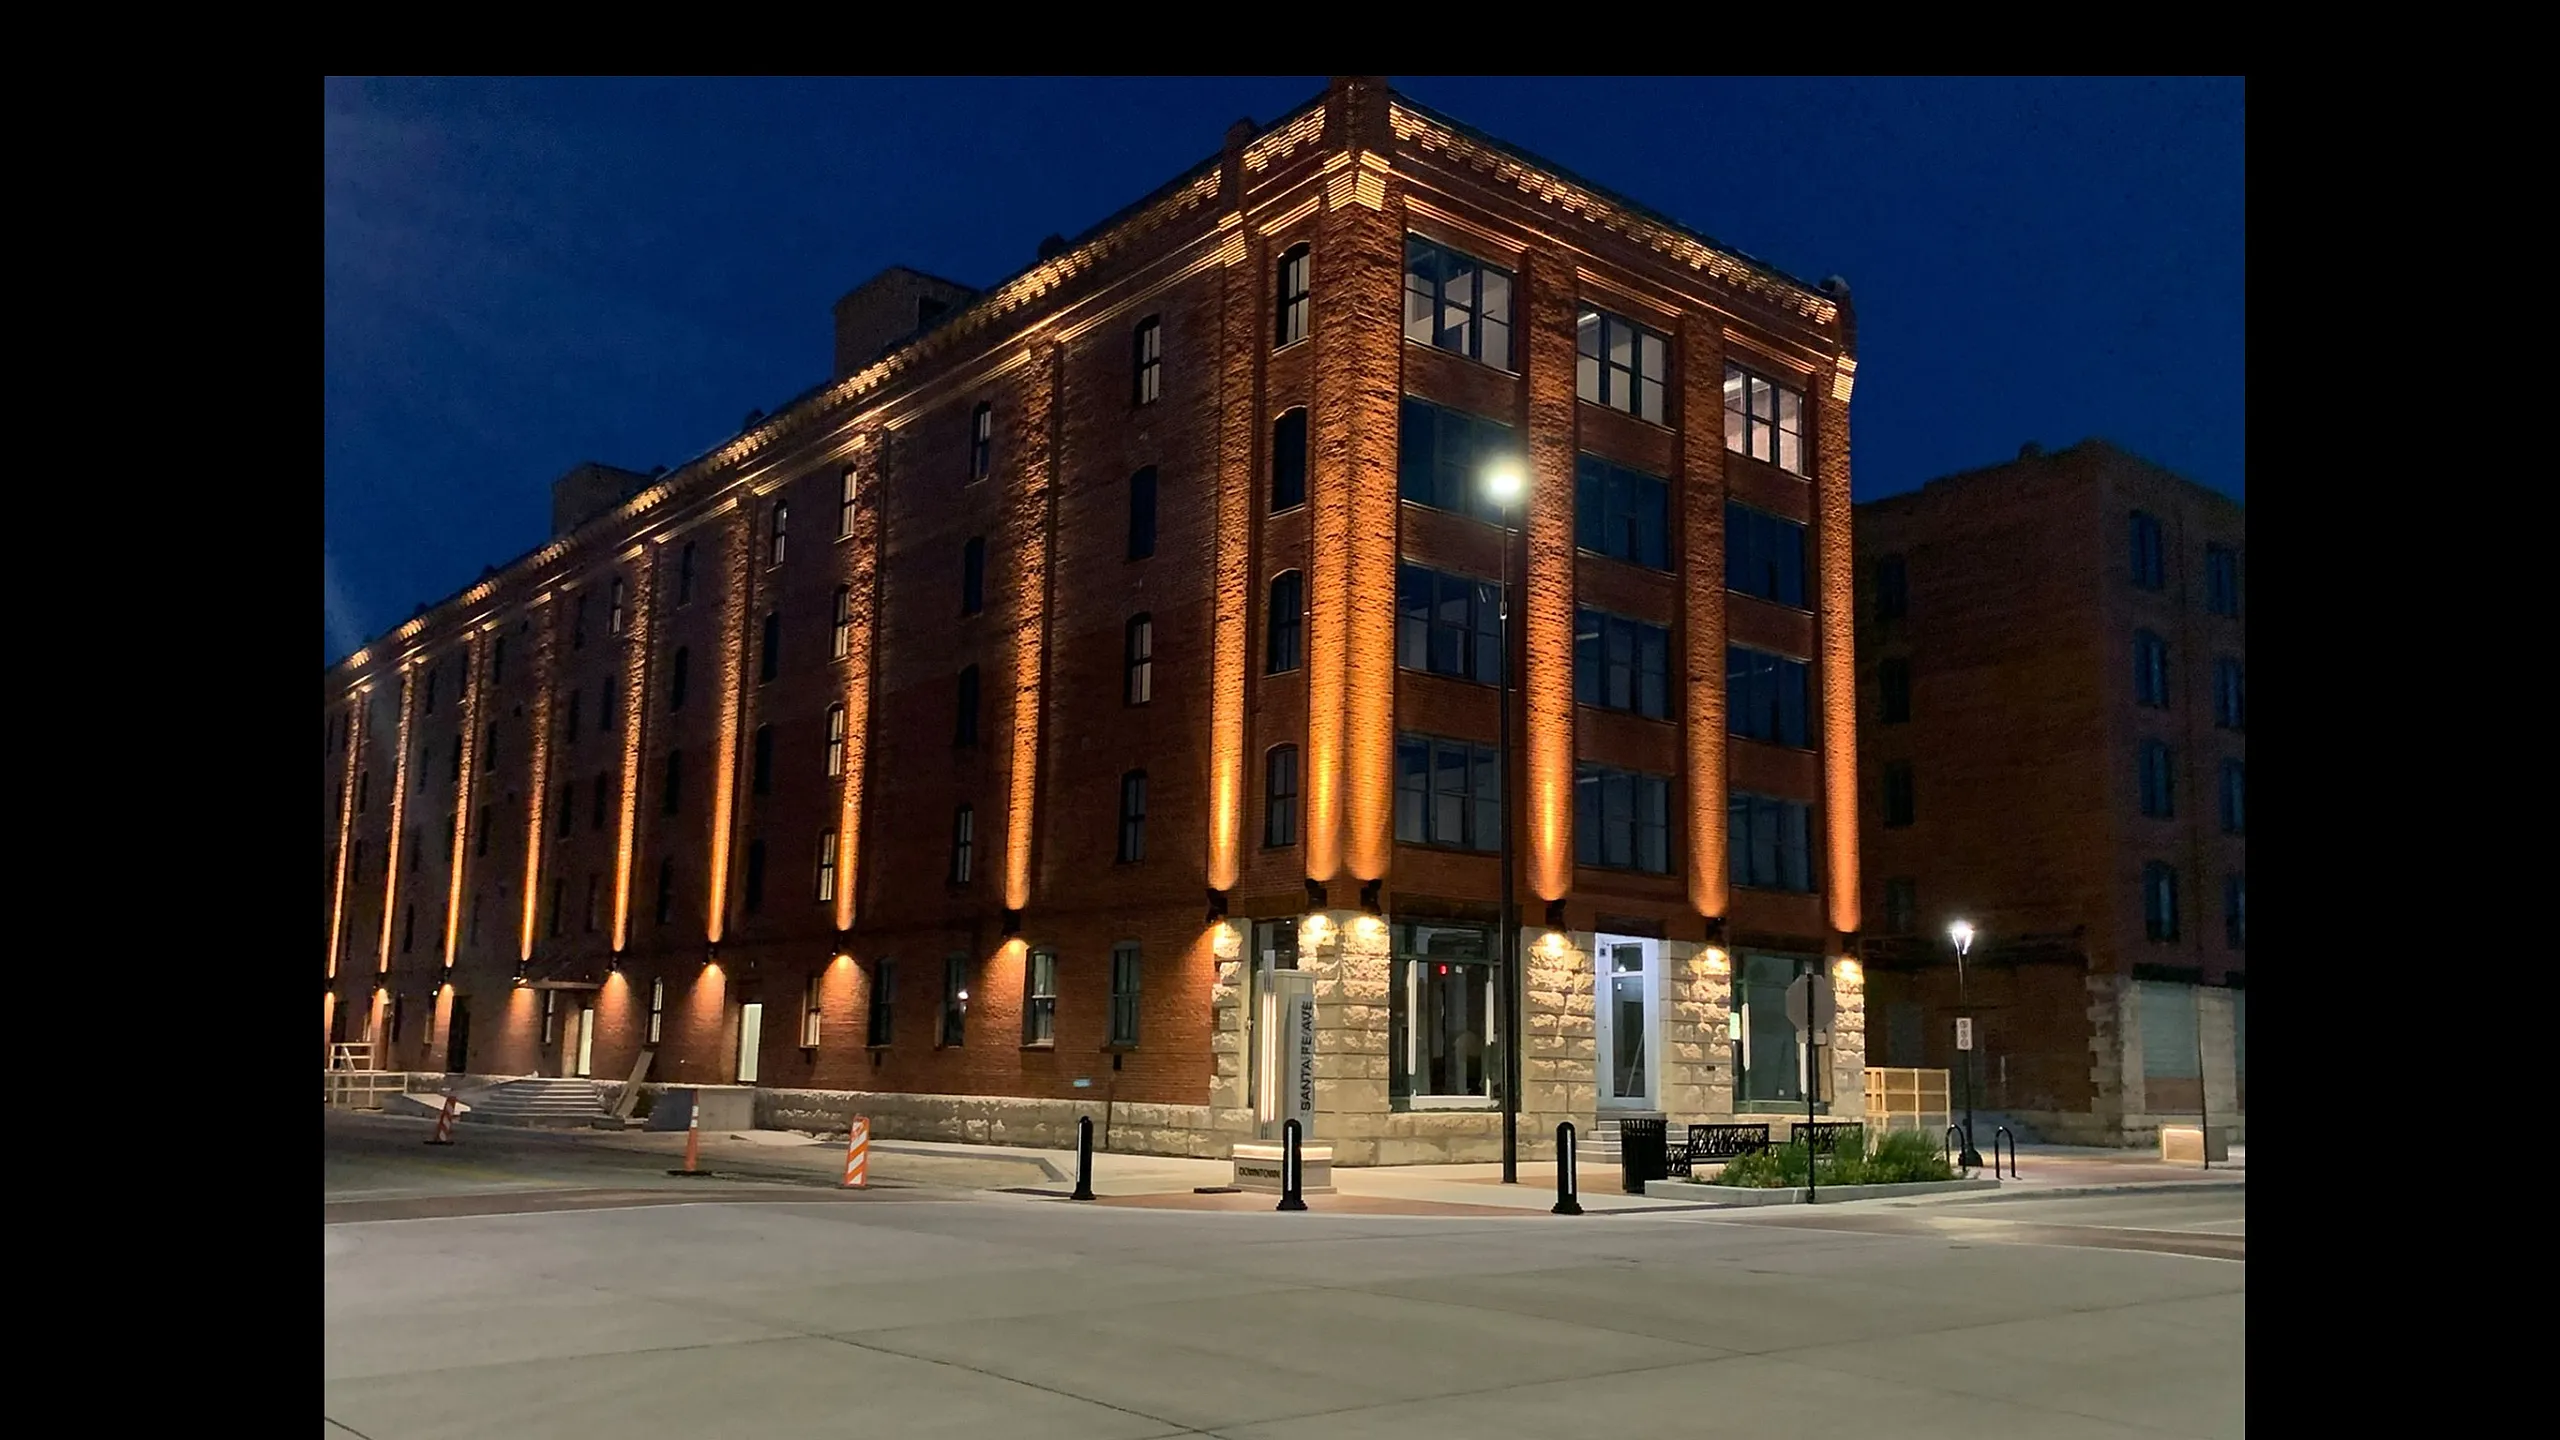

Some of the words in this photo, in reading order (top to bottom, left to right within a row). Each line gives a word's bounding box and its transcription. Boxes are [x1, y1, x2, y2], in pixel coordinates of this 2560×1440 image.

[1301, 1000, 1313, 1032] AVE
[1300, 1036, 1312, 1055] FE
[1300, 1059, 1312, 1111] SANTA
